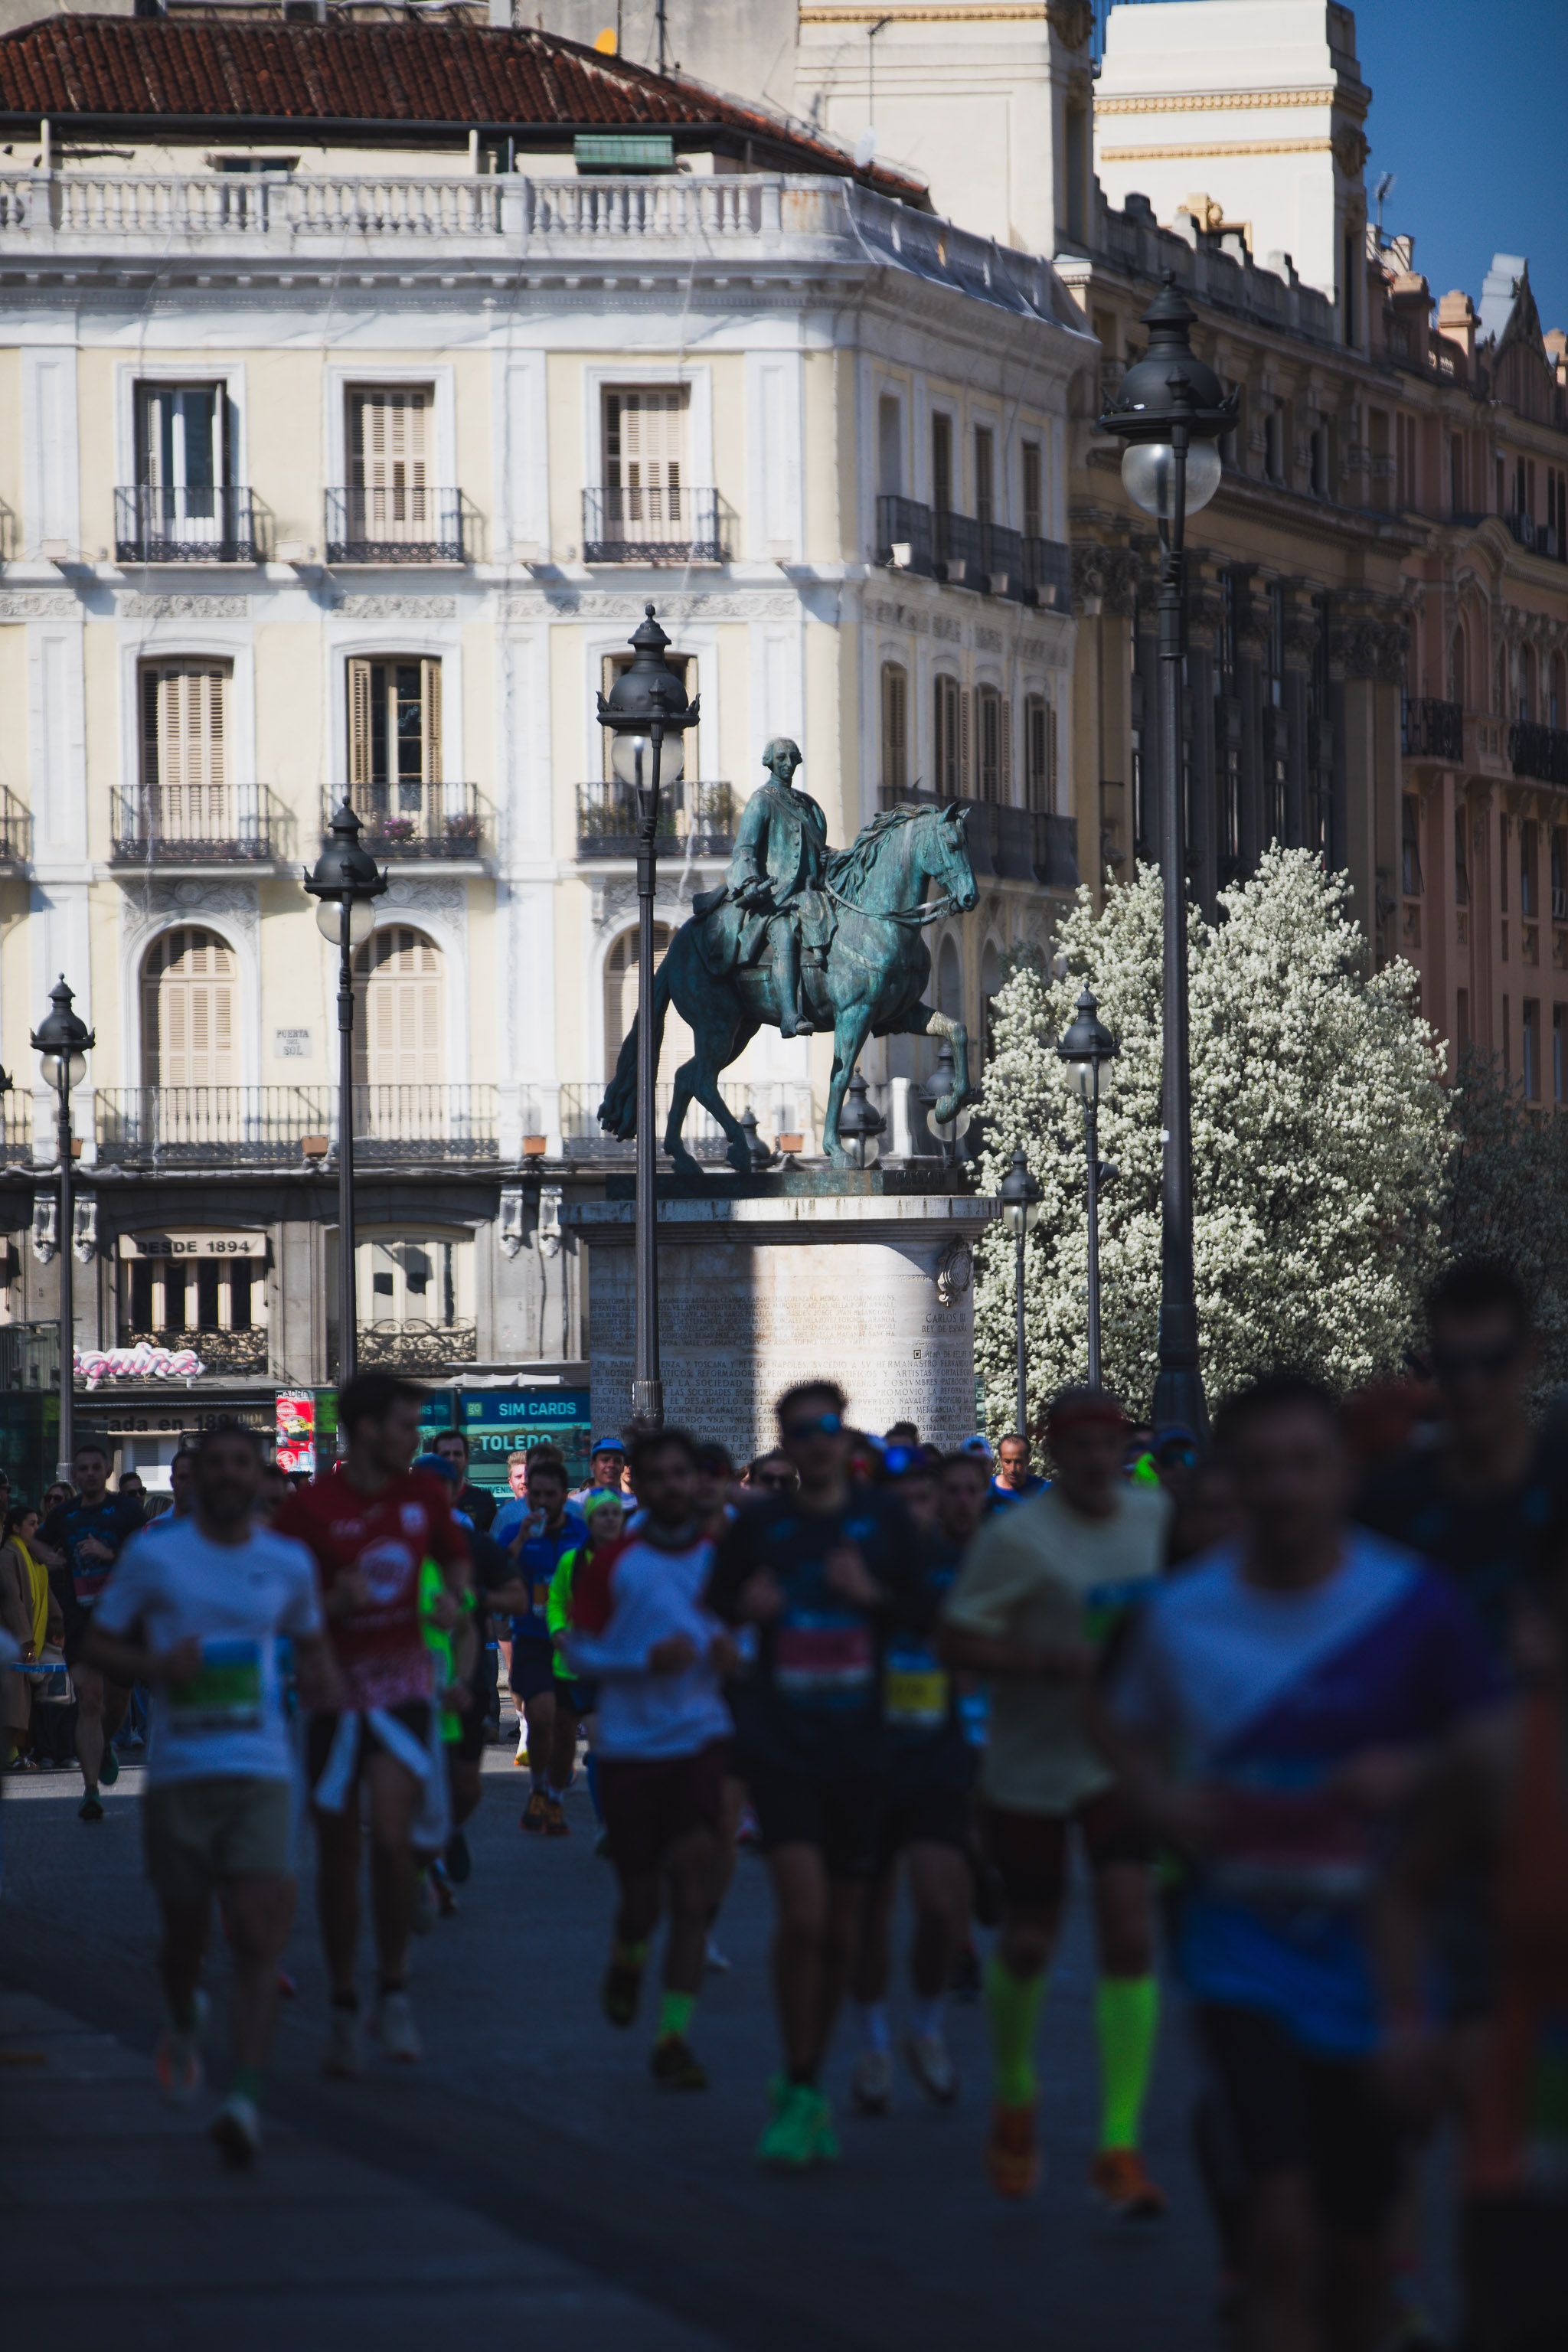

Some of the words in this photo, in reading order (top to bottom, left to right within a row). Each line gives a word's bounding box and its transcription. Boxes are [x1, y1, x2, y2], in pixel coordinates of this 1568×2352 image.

[276, 1029, 309, 1038] PUERTA
[283, 1046, 303, 1055] SOL
[136, 1241, 197, 1253] DESDE
[206, 1240, 250, 1253] 1894
[926, 1313, 957, 1323] CARLOS
[949, 1324, 967, 1332] ESPAÑA
[499, 1403, 524, 1416] SIM
[528, 1402, 577, 1416] CARDS
[158, 1419, 184, 1430] en
